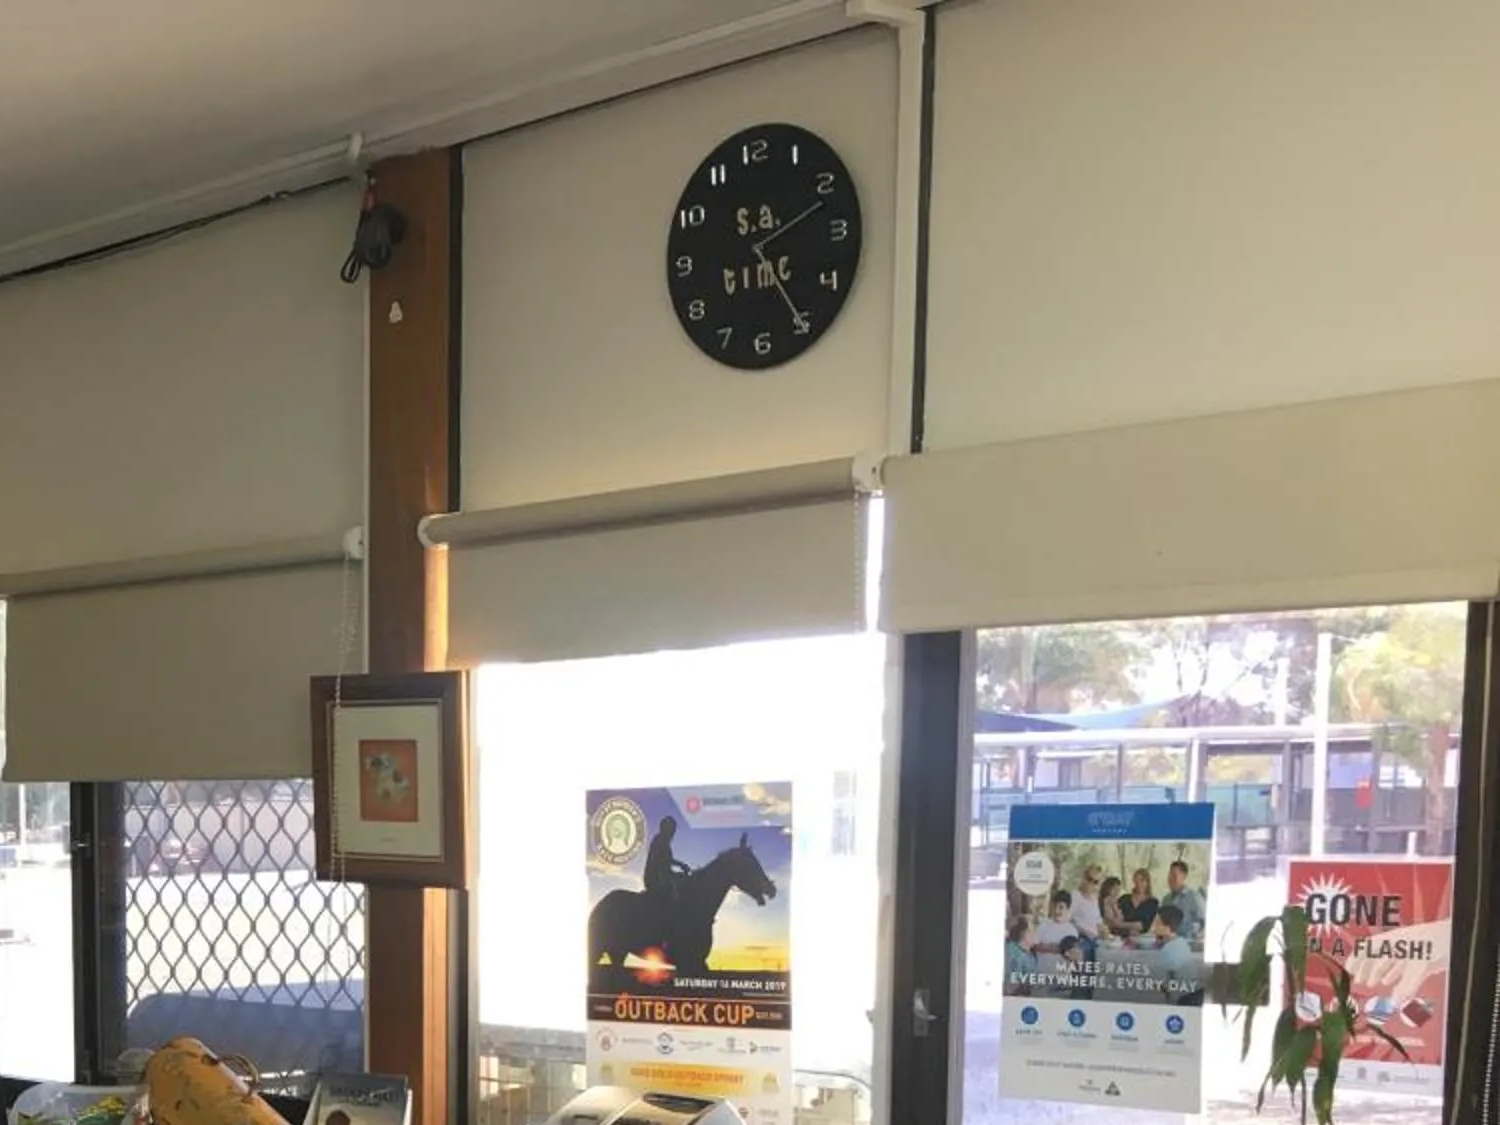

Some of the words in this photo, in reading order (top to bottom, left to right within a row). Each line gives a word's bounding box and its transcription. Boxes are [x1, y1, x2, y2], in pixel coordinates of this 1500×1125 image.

[742, 139, 769, 165] 12
[791, 144, 798, 166] 1
[710, 163, 726, 186] 11
[816, 172, 835, 194] 2
[680, 205, 705, 230] 10
[829, 219, 848, 241] 3
[675, 255, 693, 277] 9
[723, 255, 791, 295] time
[819, 269, 837, 290] 4
[688, 299, 705, 320] 8
[793, 311, 811, 334] 5
[716, 327, 733, 349] 7
[753, 333, 771, 354] 6
[1305, 893, 1403, 927] GONE
[1331, 939, 1345, 957] A
[1354, 939, 1433, 961] FLASH!
[1055, 961, 1102, 974] MATES
[731, 979, 763, 990] MARCH
[1116, 978, 1164, 992] EVERY
[1167, 980, 1198, 994] DAY
[614, 1000, 708, 1024] OUTBACK
[713, 1004, 755, 1025] CUP
